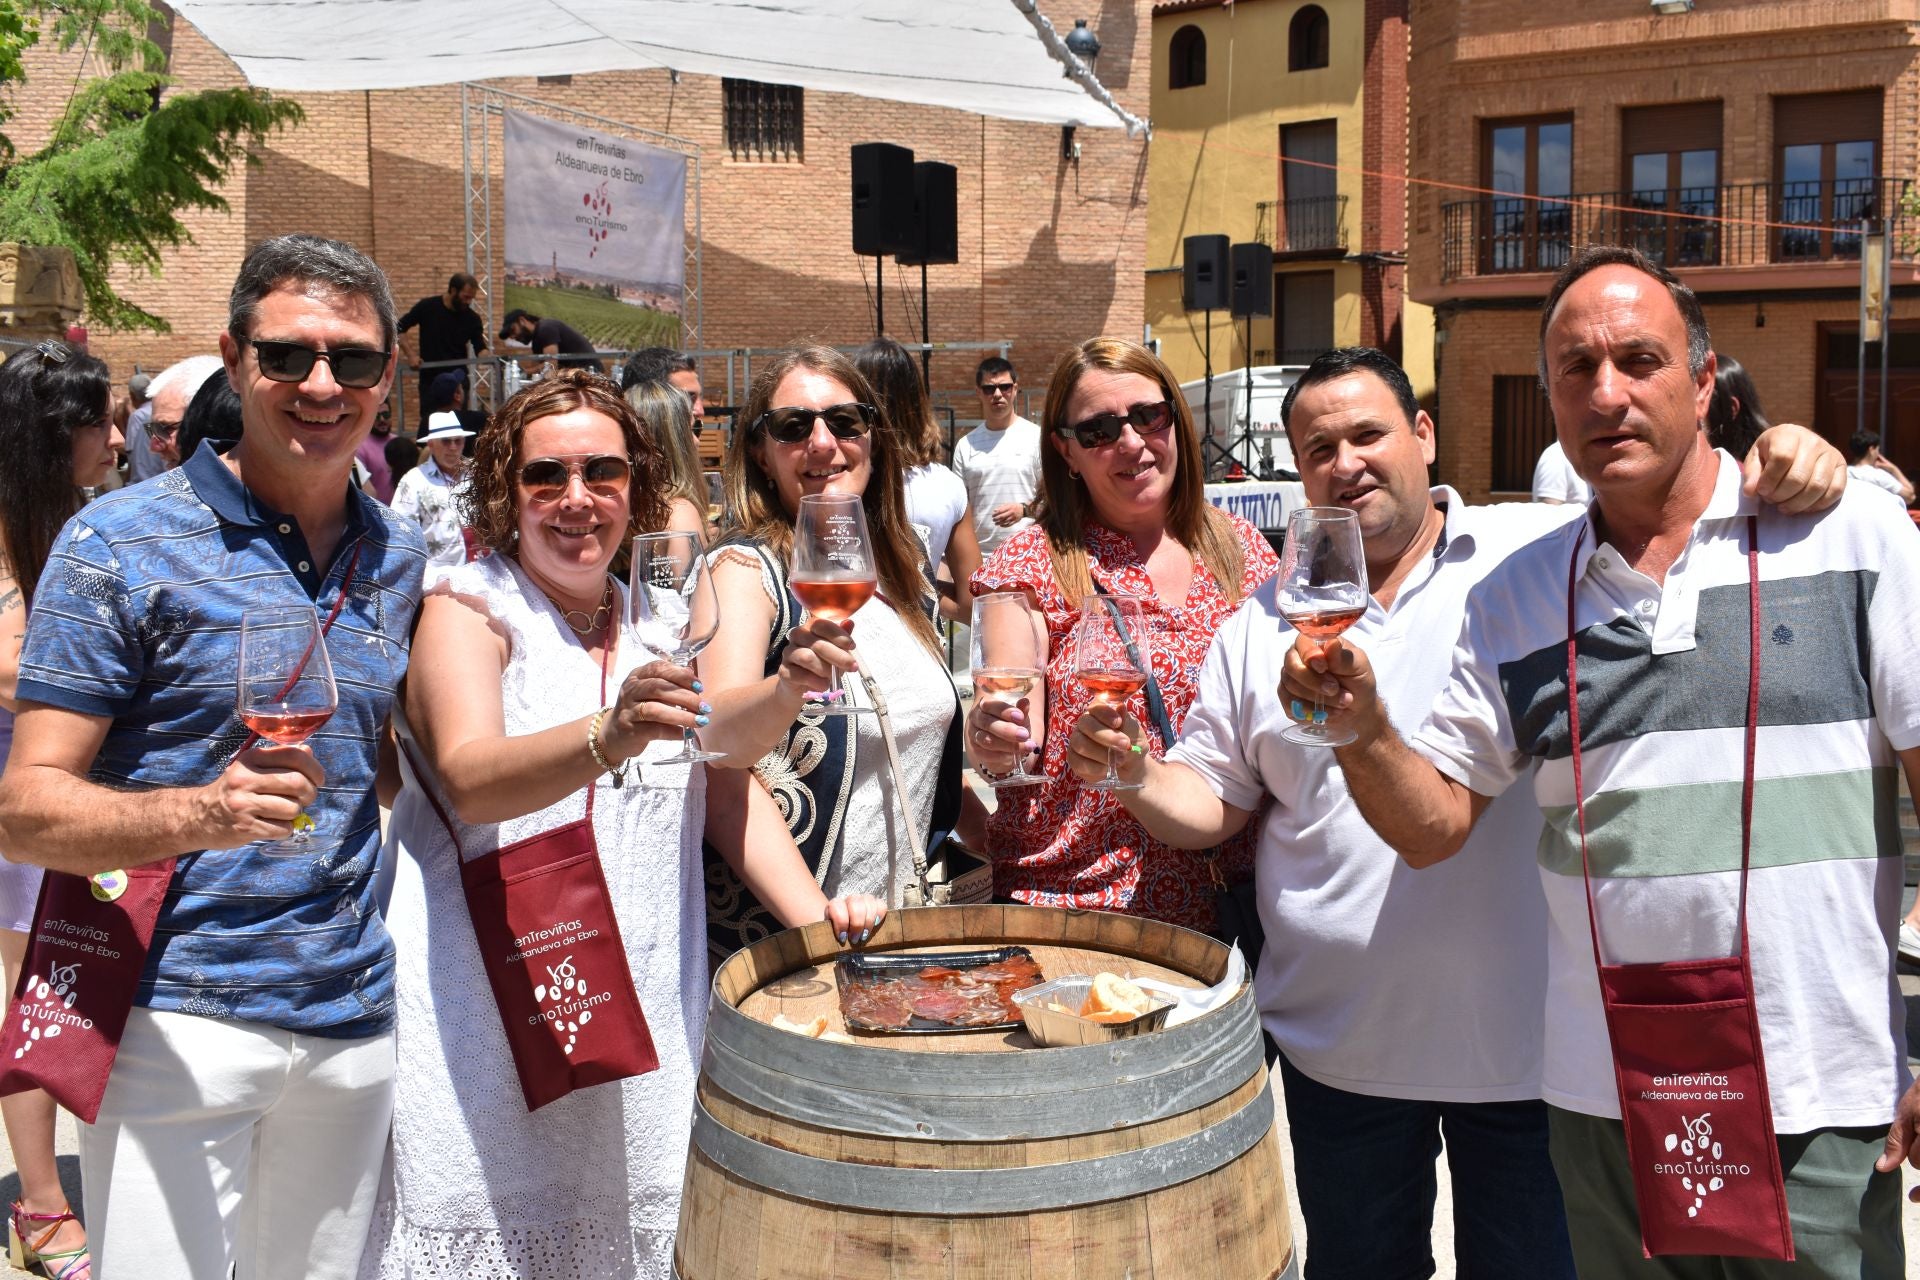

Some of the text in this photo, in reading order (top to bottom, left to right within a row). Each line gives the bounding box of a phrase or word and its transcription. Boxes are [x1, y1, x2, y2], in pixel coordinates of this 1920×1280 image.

[576, 136, 626, 160] enTreviñas
[555, 151, 645, 185] Aldeanueva de Ebro
[575, 214, 628, 232] enoTurismo
[1241, 492, 1282, 528] VINO
[44, 919, 110, 942] enTreviñas
[514, 919, 582, 948] enTreviñas
[80, 942, 95, 953] de
[96, 945, 120, 959] Ebro
[506, 928, 598, 964] Aldeanueva de Ebro
[528, 991, 612, 1026] enoTurismo
[1653, 1073, 1728, 1086] enTreviñas
[1641, 1090, 1744, 1100] Aldeanueva de Ebro
[1654, 1161, 1750, 1175] enoTurismo
